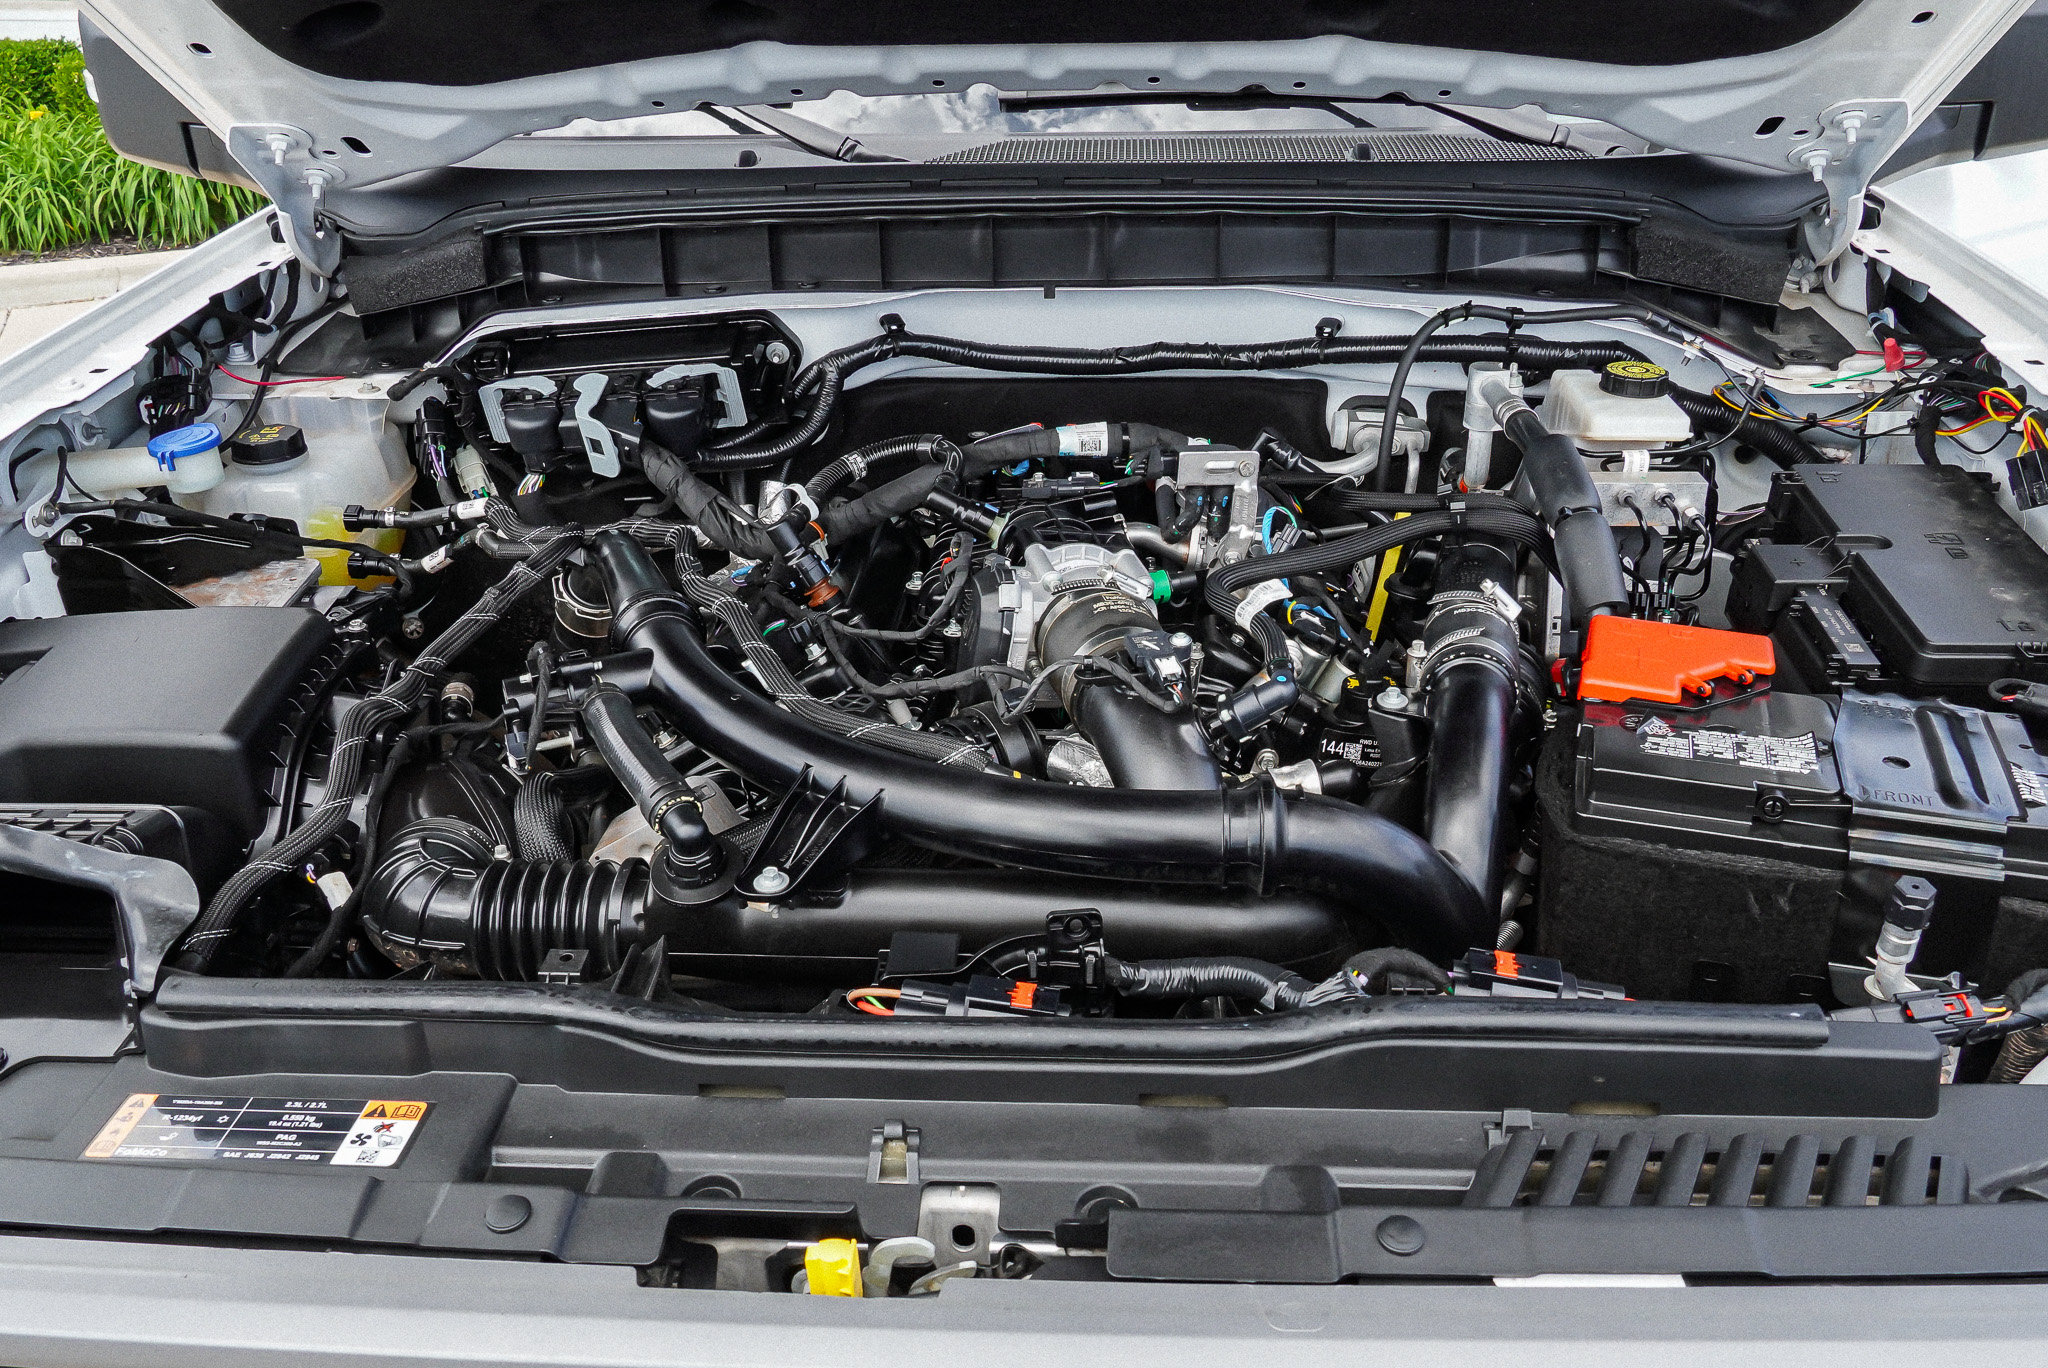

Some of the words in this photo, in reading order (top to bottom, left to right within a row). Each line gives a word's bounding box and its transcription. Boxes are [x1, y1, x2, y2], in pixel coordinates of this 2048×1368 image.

[1321, 738, 1344, 756] 144
[1873, 789, 1933, 807] FRONT
[162, 1114, 204, 1123] R-1234yf
[114, 1146, 168, 1157] FoMoCo
